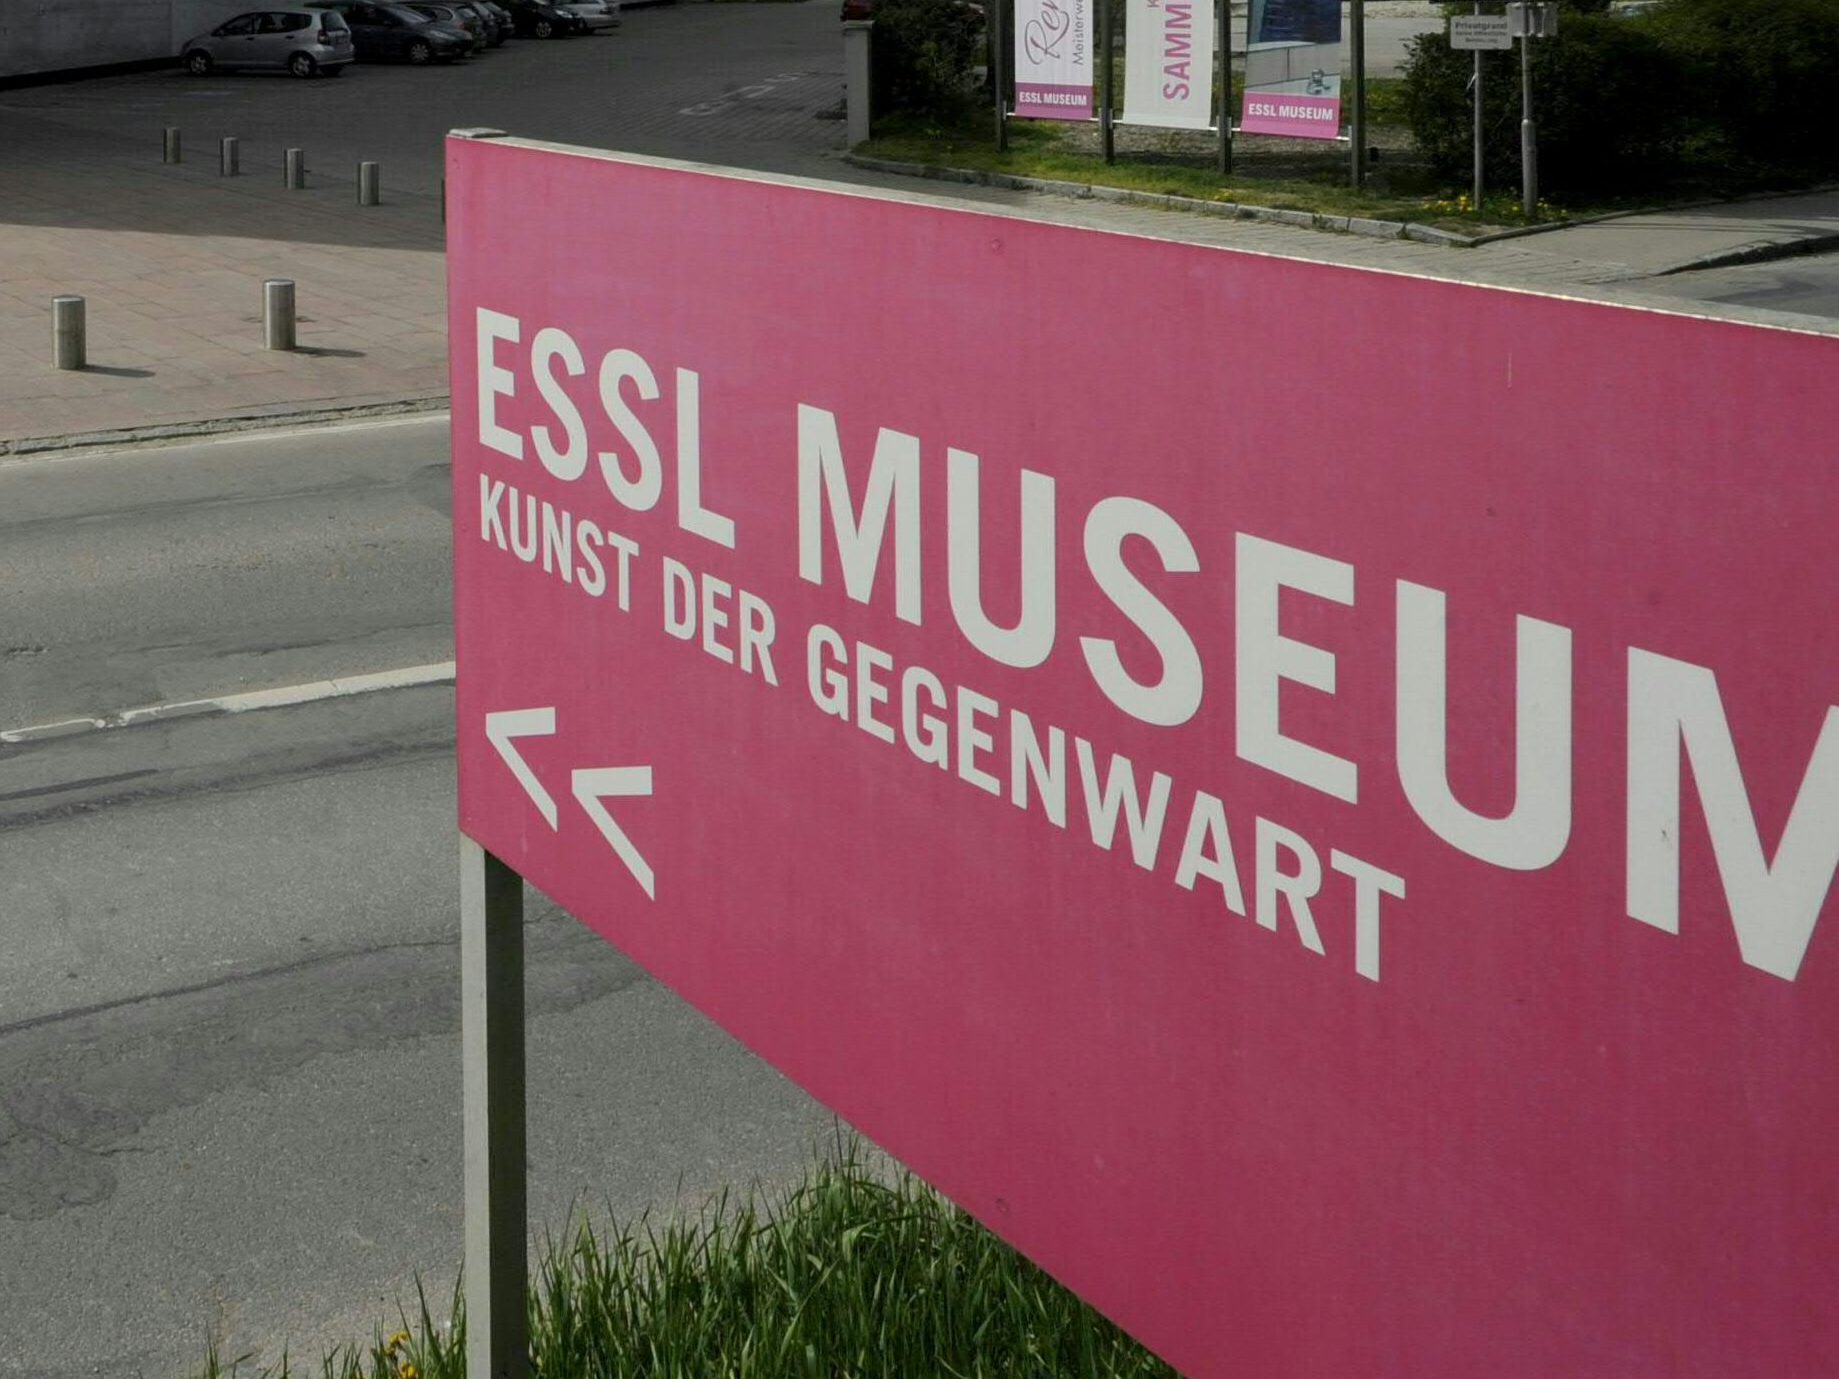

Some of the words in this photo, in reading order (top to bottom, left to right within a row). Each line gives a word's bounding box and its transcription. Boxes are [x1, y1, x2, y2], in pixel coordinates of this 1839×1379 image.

[1019, 92, 1042, 103] ESSL
[1043, 93, 1087, 106] MUSEUM
[1248, 103, 1276, 117] ESSL
[1278, 104, 1334, 121] MUSEUM
[475, 306, 735, 549] ESSL
[798, 402, 1839, 982] MUSEUM
[479, 474, 639, 612] KUNST
[664, 556, 778, 685] DER
[808, 625, 1405, 982] GEGENWART
